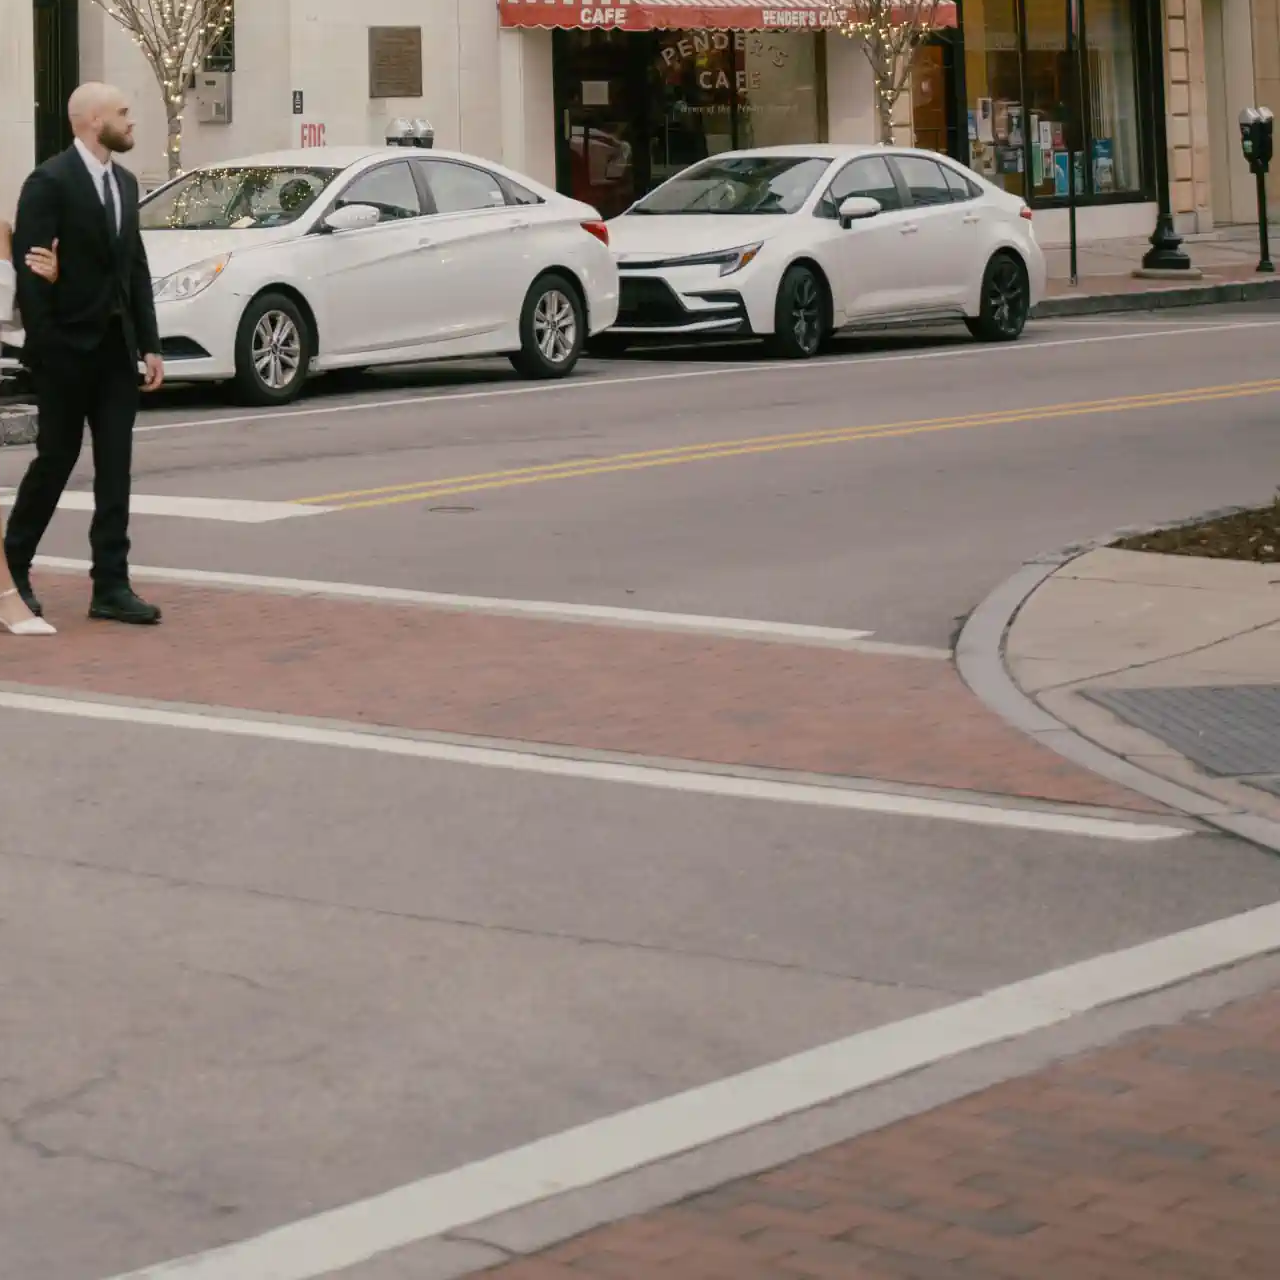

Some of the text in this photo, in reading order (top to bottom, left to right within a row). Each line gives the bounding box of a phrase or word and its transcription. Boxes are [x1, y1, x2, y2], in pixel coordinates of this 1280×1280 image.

[580, 7, 627, 25] CAFE
[762, 9, 816, 27] PENDER'S
[699, 71, 762, 90] CAFE
[300, 123, 326, 149] FDC
